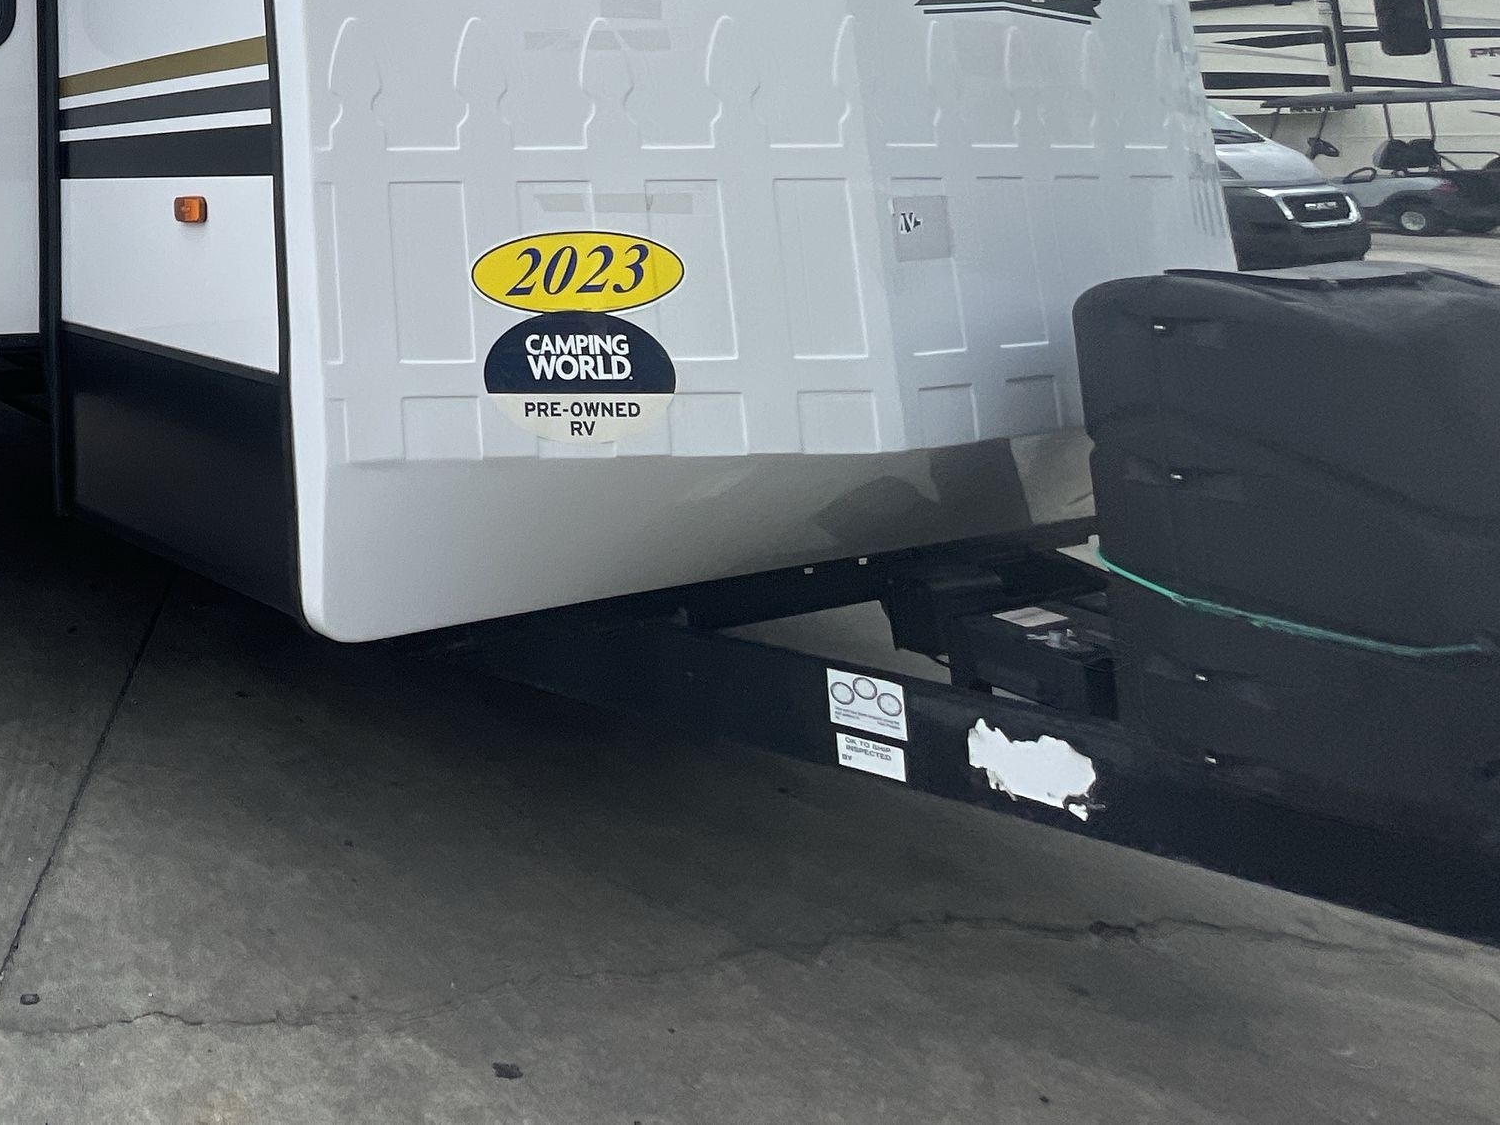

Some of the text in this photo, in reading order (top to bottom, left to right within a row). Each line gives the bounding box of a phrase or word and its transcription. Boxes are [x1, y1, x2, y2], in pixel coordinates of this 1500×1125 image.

[505, 244, 649, 296] 2023
[525, 334, 630, 356] CAMPING
[526, 355, 632, 380] WORLD
[524, 401, 641, 418] PRE-OWNED
[570, 421, 596, 436] RV
[859, 740, 870, 749] TO
